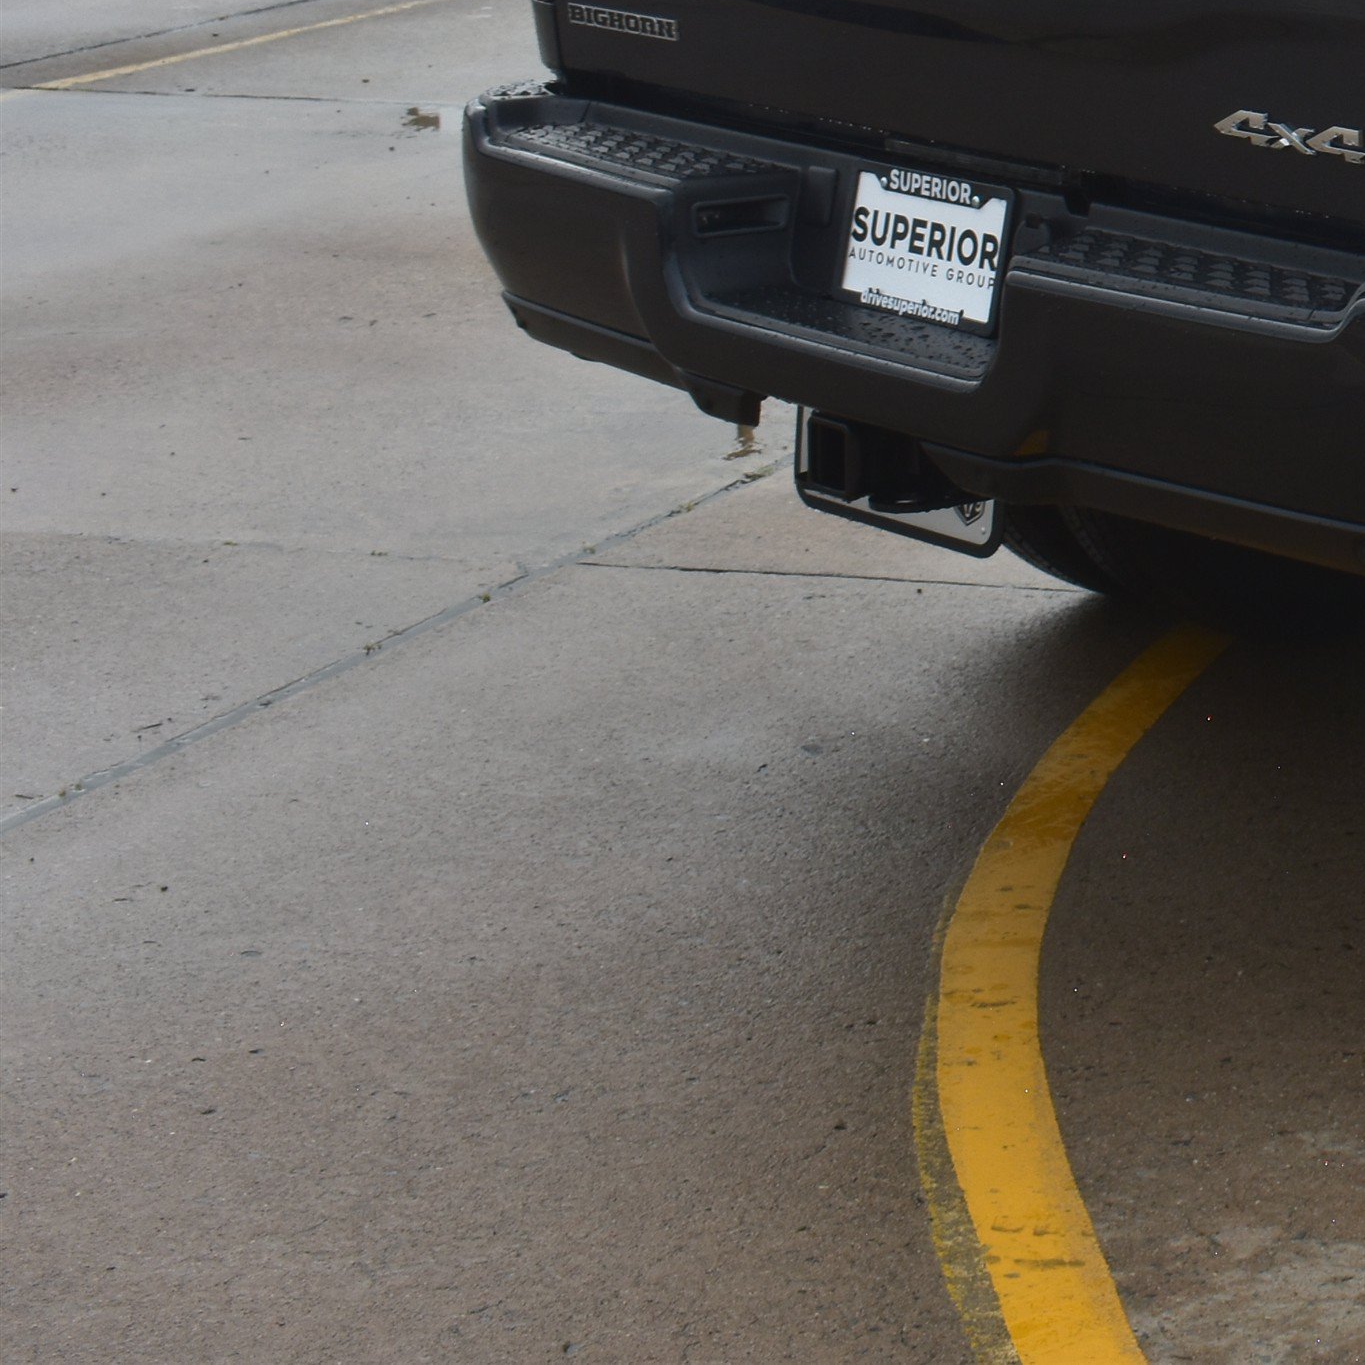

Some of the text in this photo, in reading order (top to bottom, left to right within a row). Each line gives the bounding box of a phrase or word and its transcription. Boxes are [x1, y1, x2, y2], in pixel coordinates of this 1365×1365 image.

[889, 168, 971, 205] SUPERIOR
[852, 206, 999, 271] SUPERIOR
[849, 246, 995, 290] AUTOMOTIVE GROUP
[860, 288, 961, 325] drivesuperior.com
